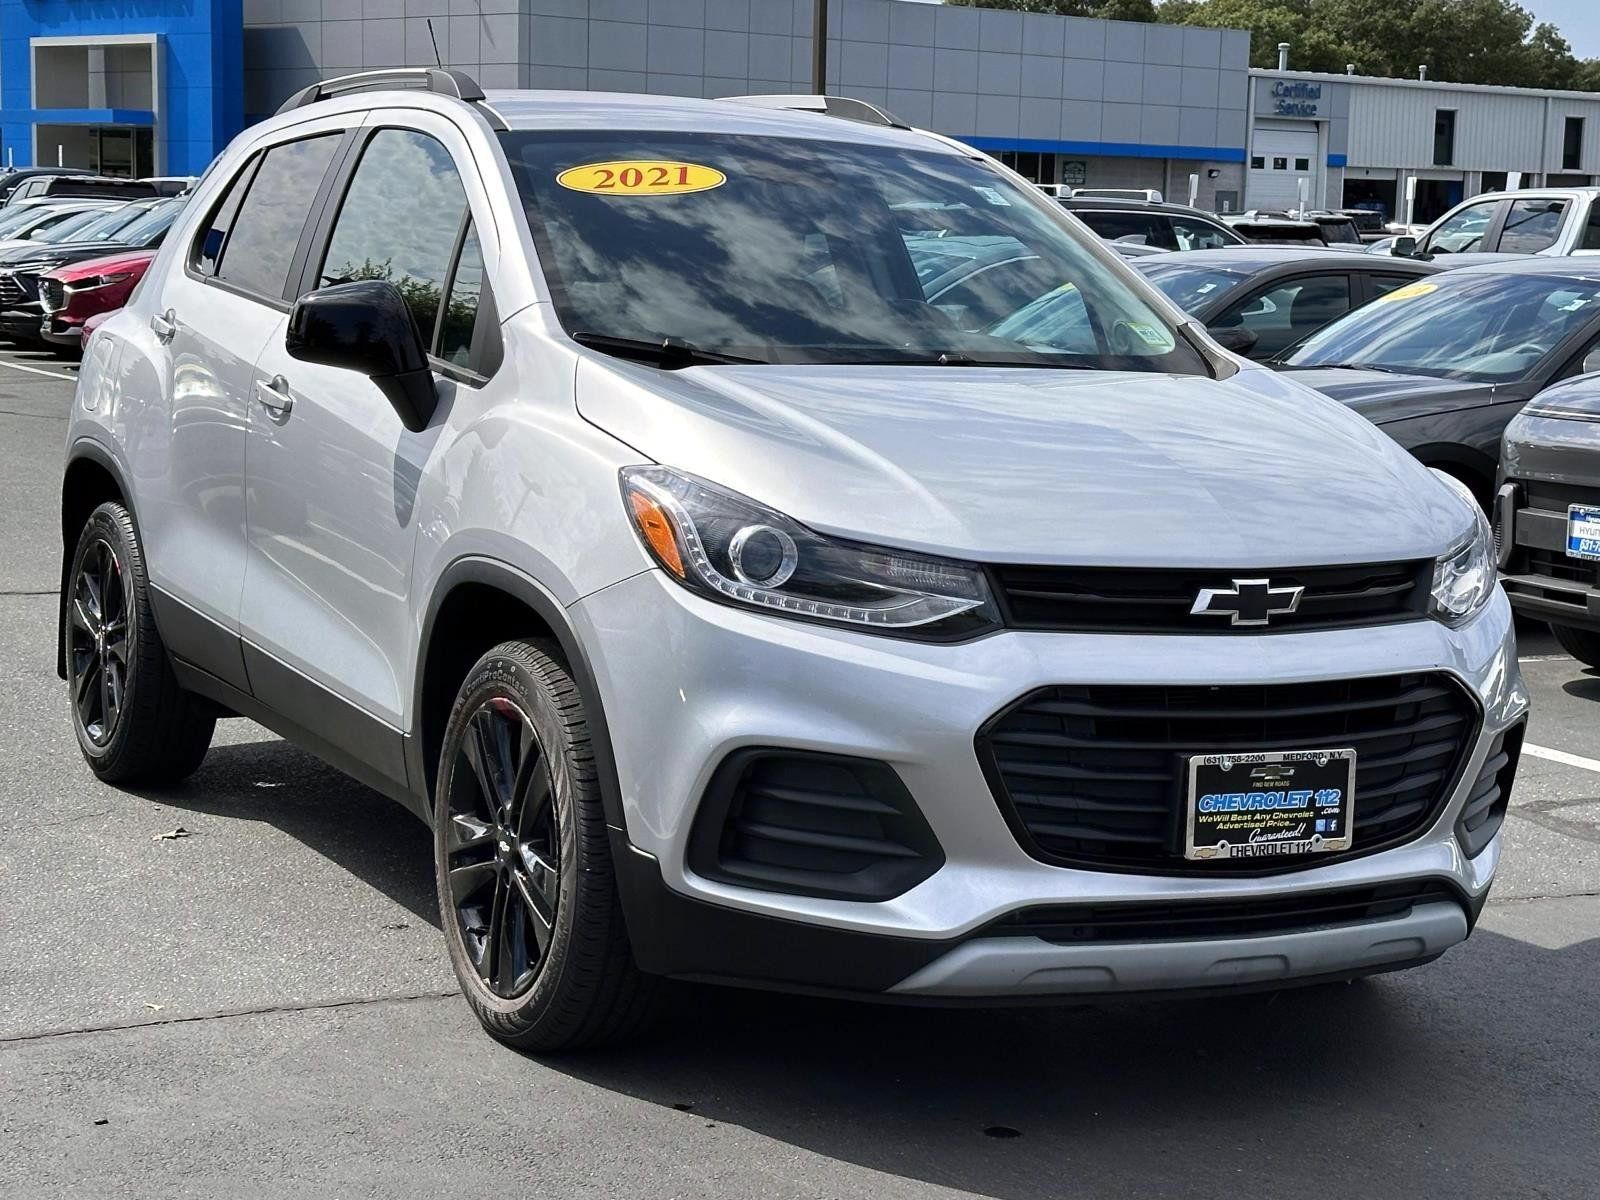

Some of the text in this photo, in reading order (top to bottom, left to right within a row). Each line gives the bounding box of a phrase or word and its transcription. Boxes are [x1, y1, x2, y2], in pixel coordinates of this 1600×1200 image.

[1275, 81, 1322, 99] Certified
[1278, 99, 1318, 116] Service
[593, 166, 693, 189] 2021
[1203, 753, 1266, 766] (631) 758-2200
[1199, 789, 1341, 812] CHEVROLET 112
[1230, 813, 1252, 821] Beat
[1253, 812, 1271, 821] Any
[1272, 810, 1315, 820] Chevrolet
[1321, 807, 1340, 815] .com
[1216, 820, 1265, 830] Advertised
[1230, 842, 1313, 857] CHEVROLET 112
